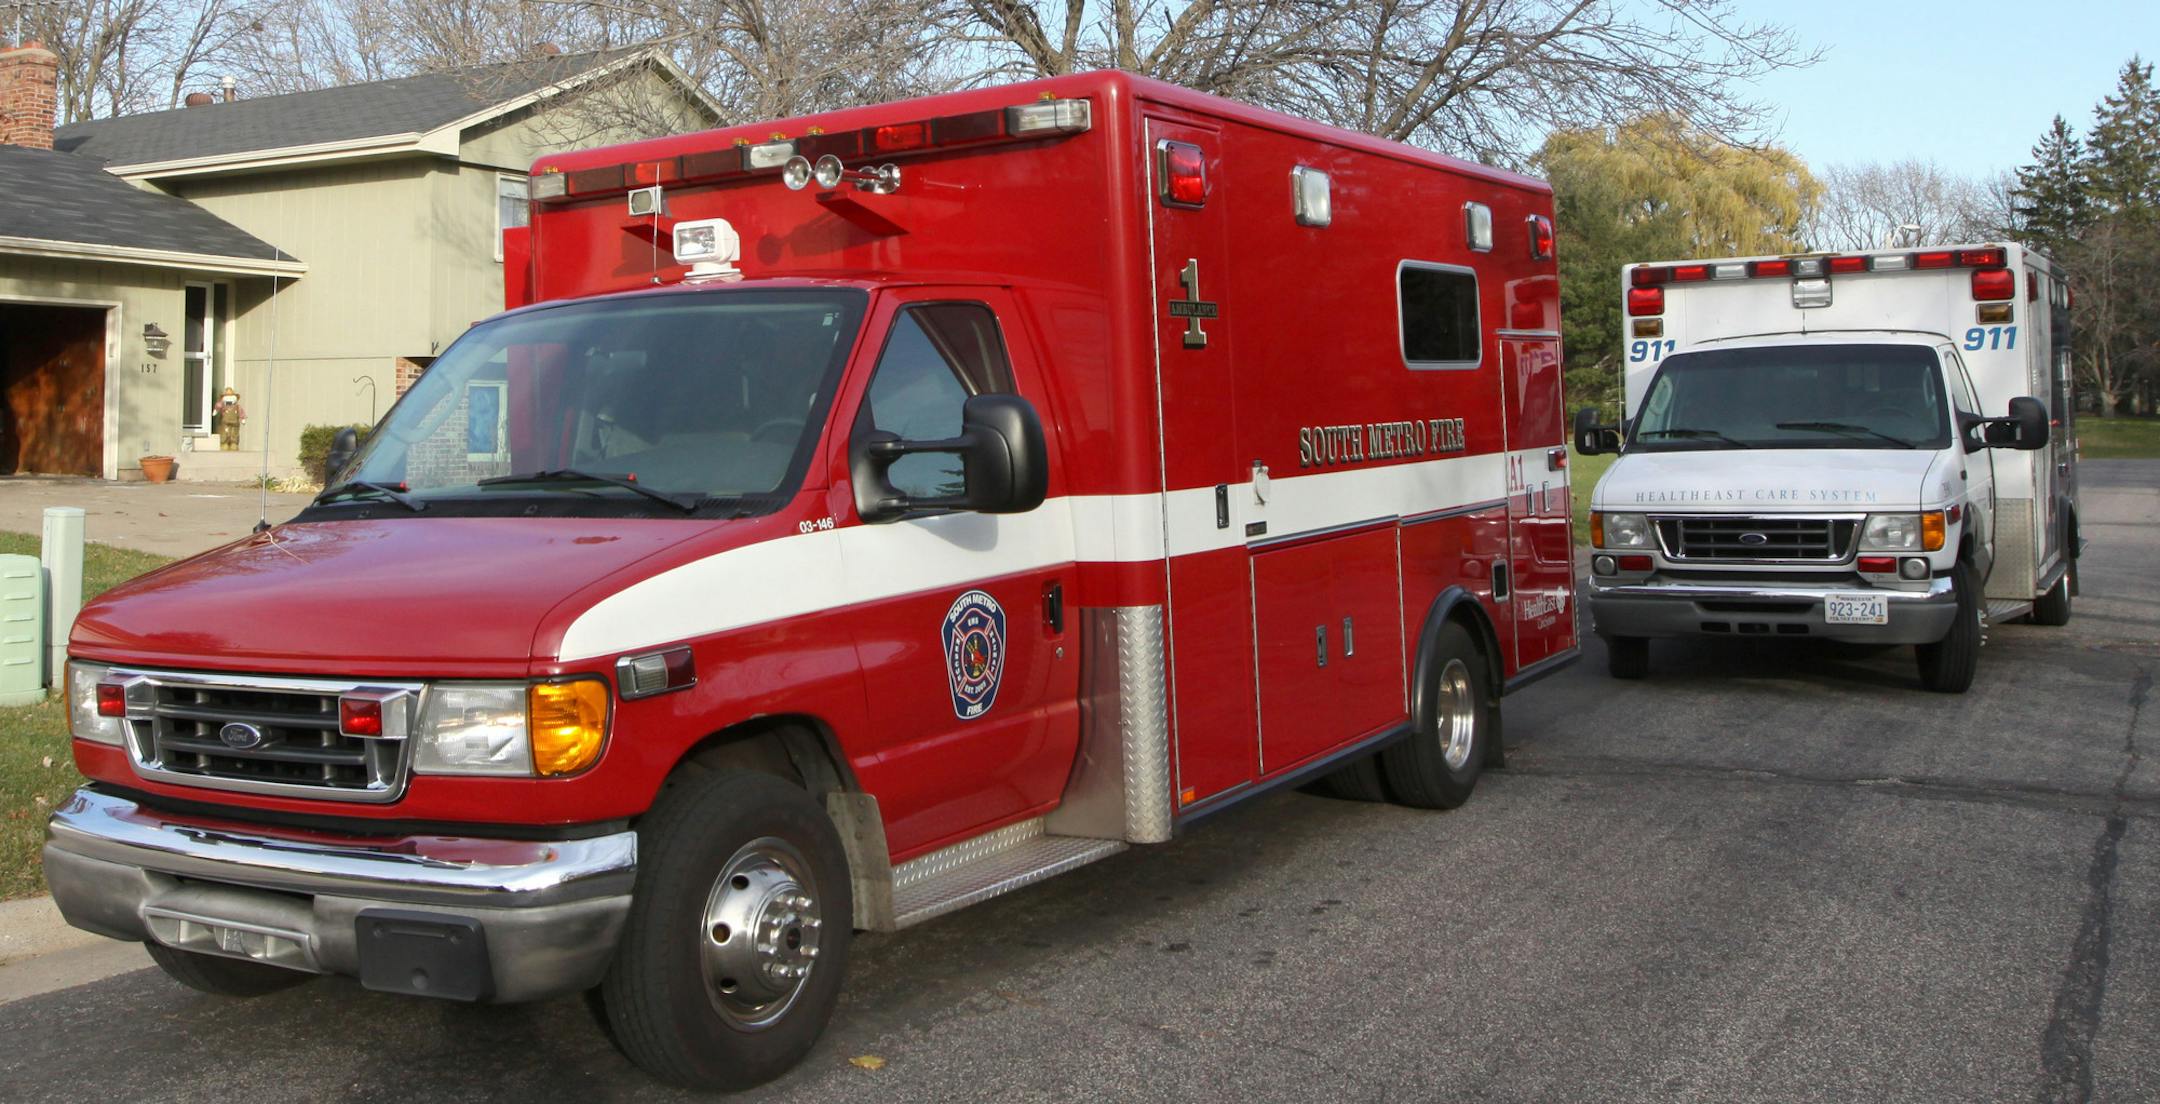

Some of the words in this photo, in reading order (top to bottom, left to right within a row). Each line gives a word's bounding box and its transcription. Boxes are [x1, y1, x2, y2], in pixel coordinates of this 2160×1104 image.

[1180, 258, 1207, 349] 1
[1963, 326, 2017, 351] 911
[141, 363, 157, 373] 157
[1299, 425, 1364, 467] SOUTH
[1366, 419, 1427, 460] METRO
[1428, 417, 1466, 452] FIRE
[1510, 455, 1525, 492] A1
[1636, 489, 1745, 502] HEALTHEAST
[1755, 489, 1799, 501] CARE
[1809, 489, 1877, 502] SYSTEM
[799, 516, 834, 533] 03-146
[950, 595, 972, 622] SOUTH
[972, 594, 997, 613] METRO
[1829, 602, 1884, 617] 923-241
[966, 702, 983, 716] FIRE
